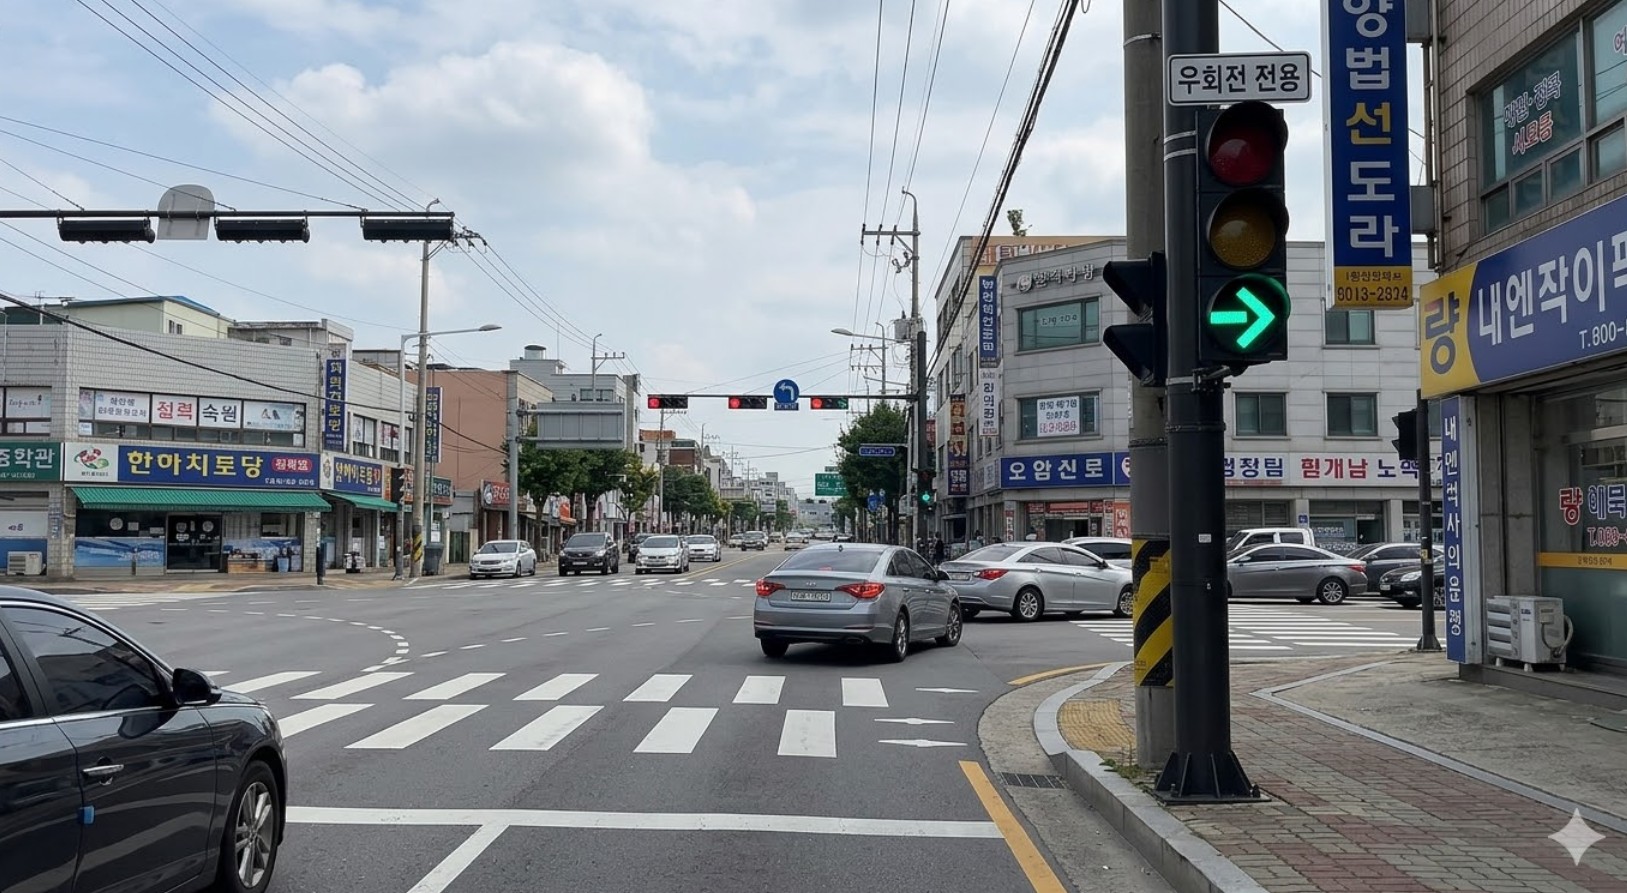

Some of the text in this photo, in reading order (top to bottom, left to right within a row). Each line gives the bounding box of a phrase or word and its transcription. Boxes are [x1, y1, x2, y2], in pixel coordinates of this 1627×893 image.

[1178, 63, 1300, 94] 우회전 전용
[1579, 320, 1627, 349] T.800-
[1009, 458, 1103, 481] 오암진로
